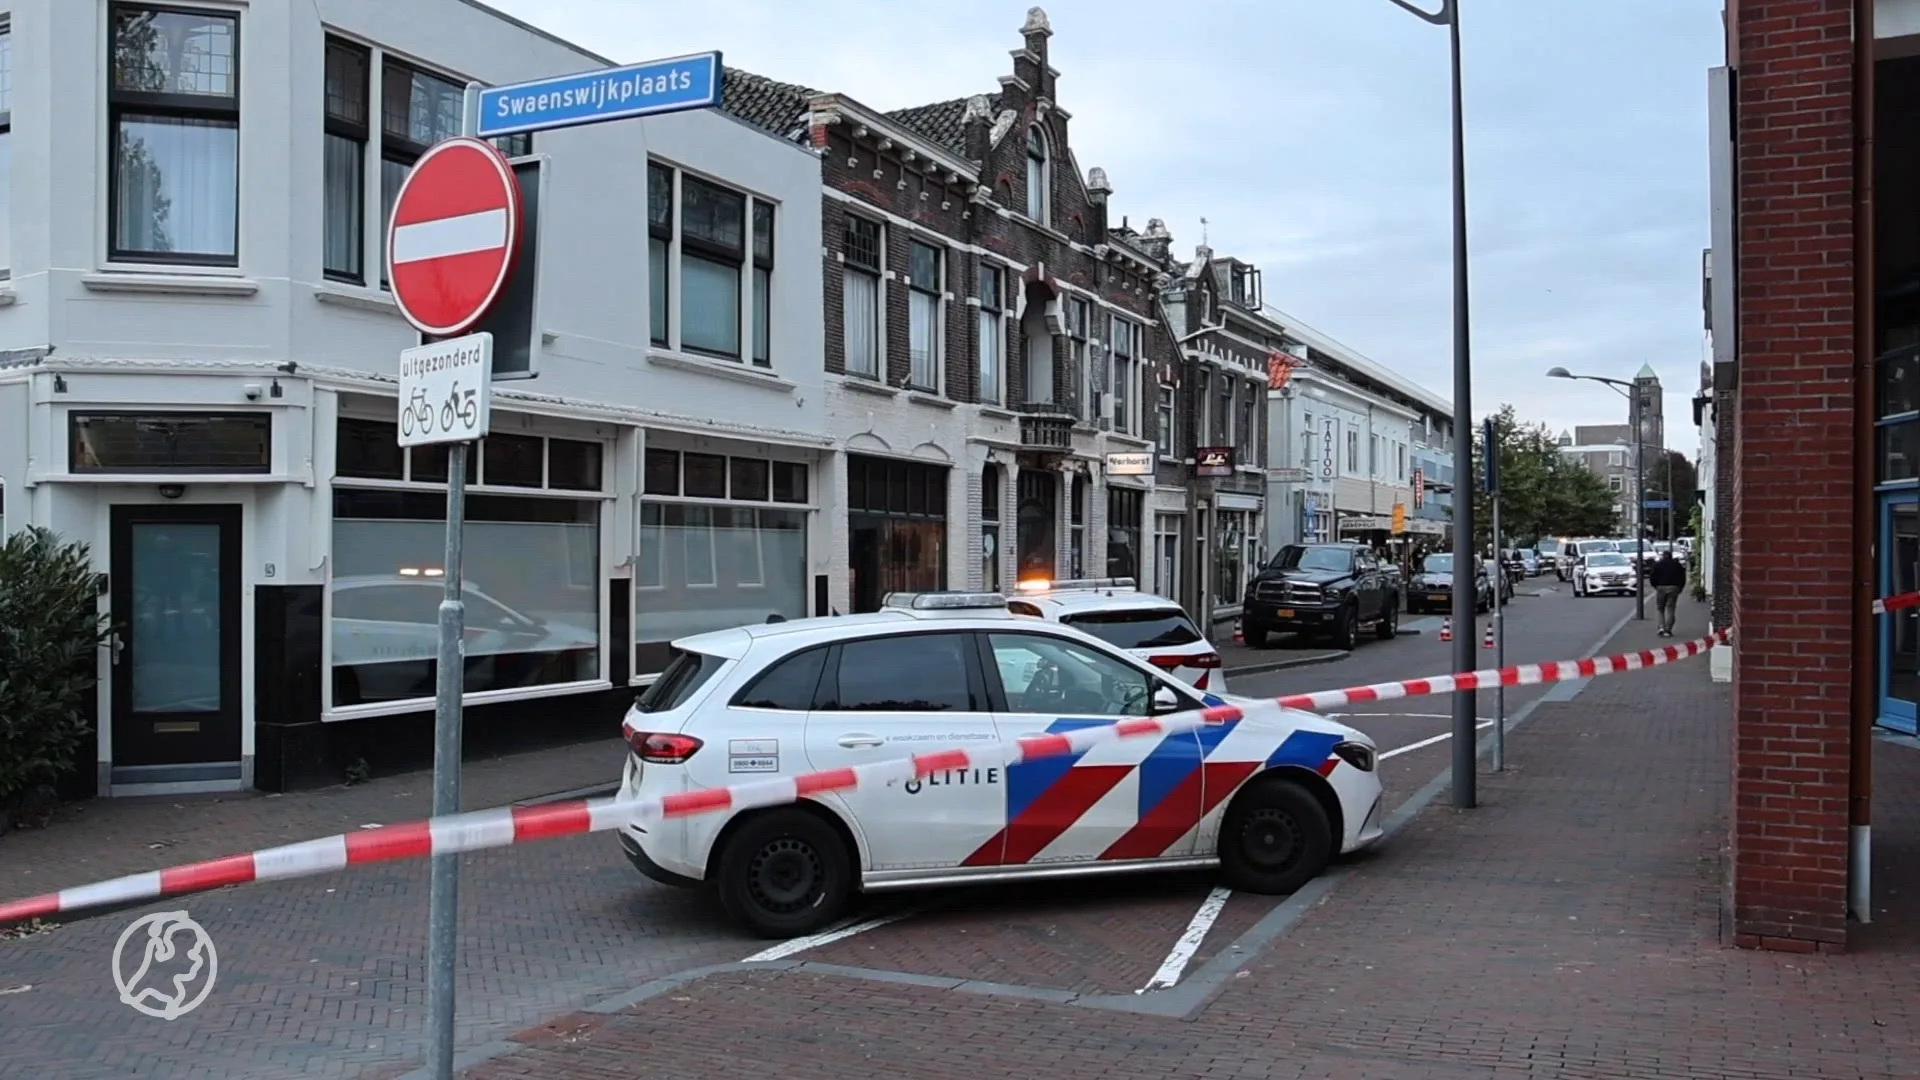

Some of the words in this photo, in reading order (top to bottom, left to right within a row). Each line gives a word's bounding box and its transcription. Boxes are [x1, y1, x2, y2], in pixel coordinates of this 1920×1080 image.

[497, 68, 692, 117] Swaenswijkplaats
[403, 343, 480, 380] uitgezonderd
[1323, 420, 1333, 477] TATTOO
[886, 767, 999, 795] OLITIE
